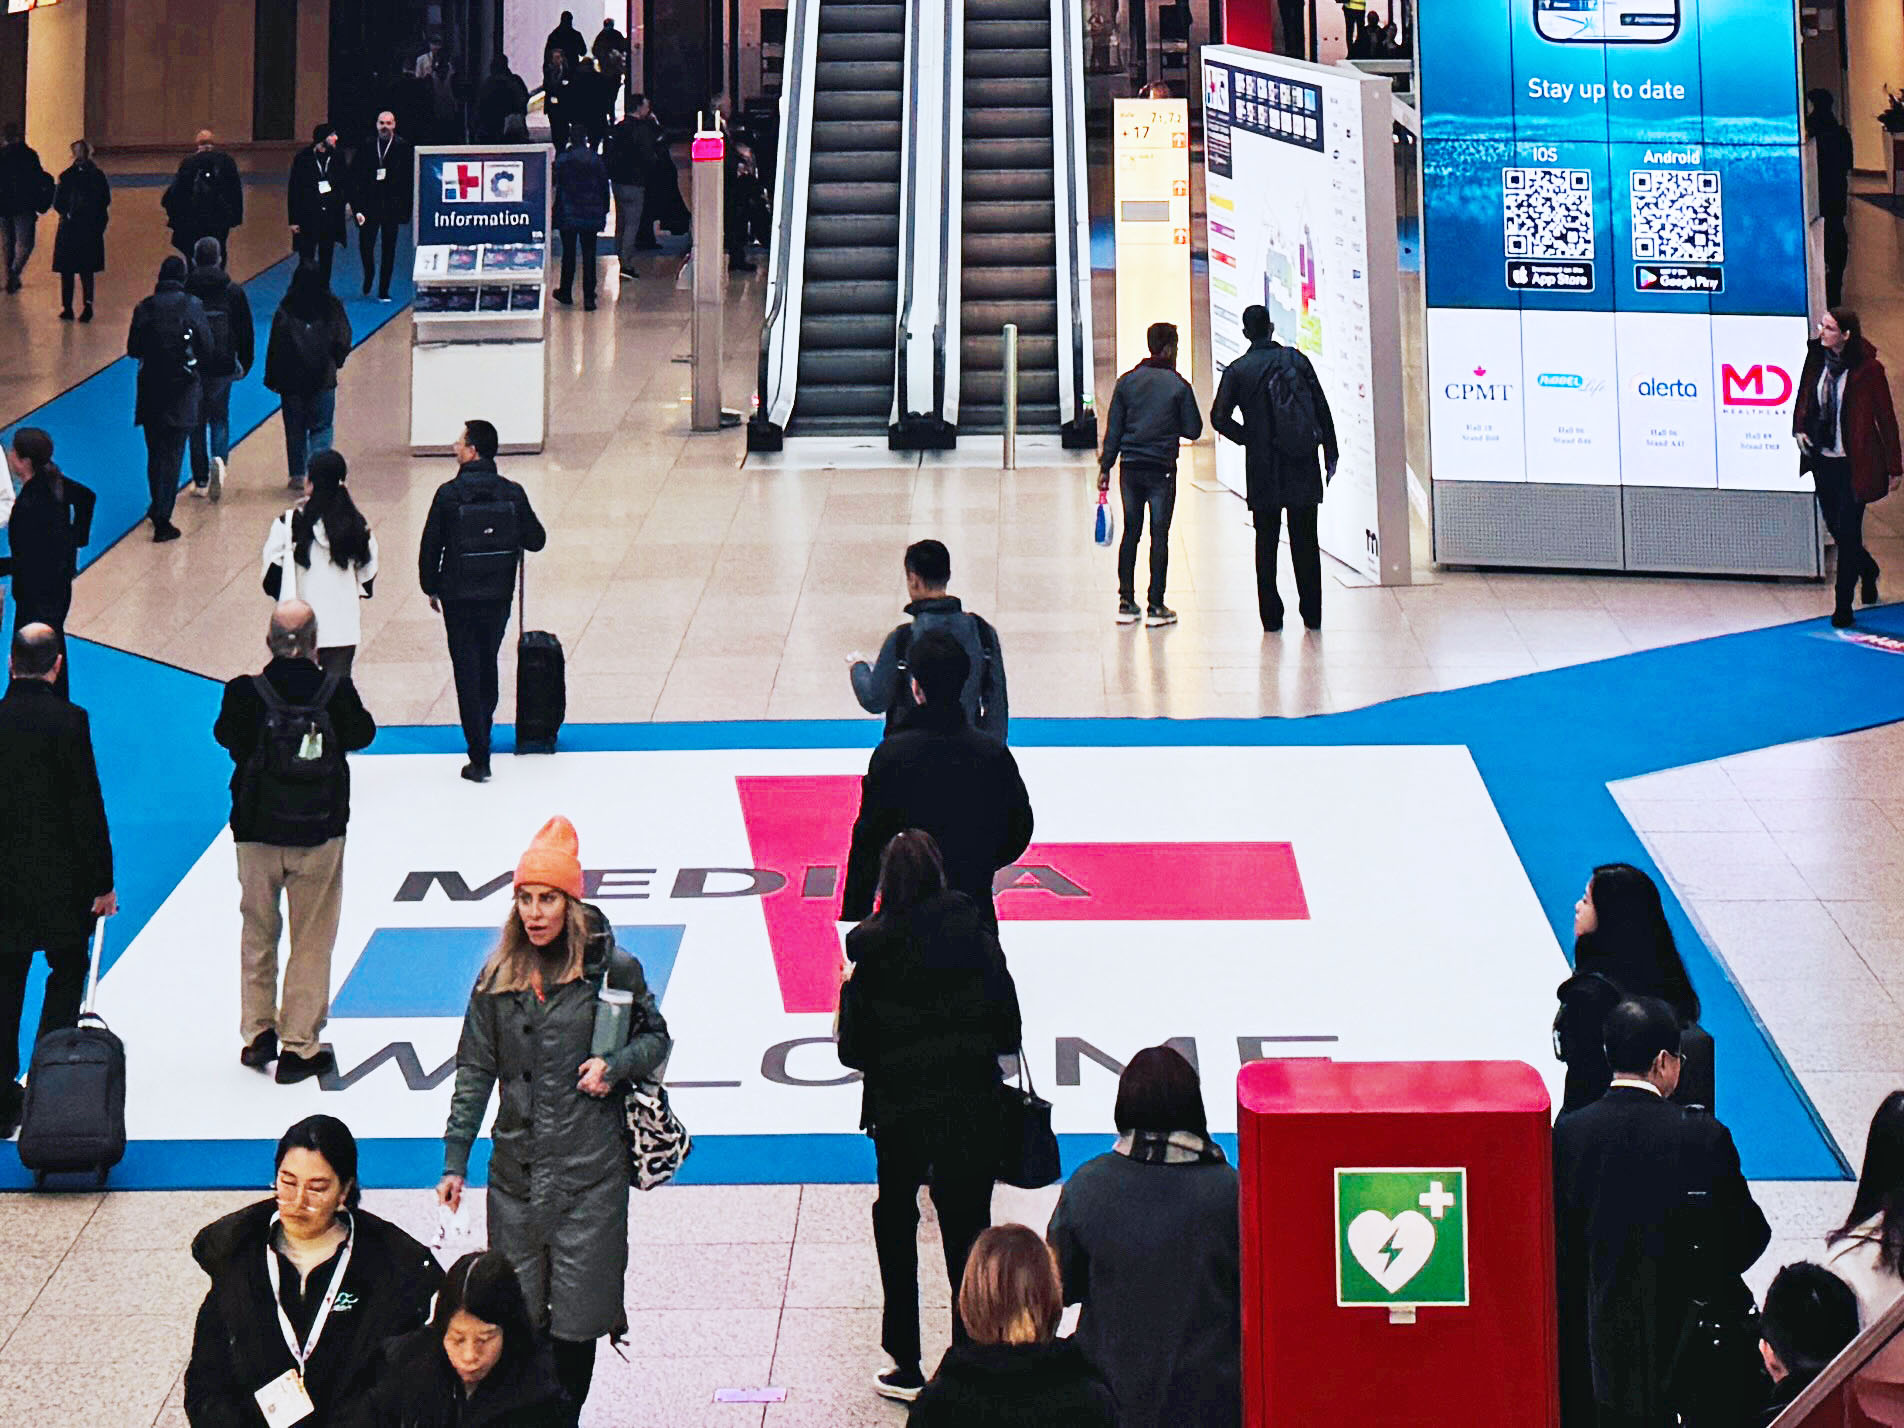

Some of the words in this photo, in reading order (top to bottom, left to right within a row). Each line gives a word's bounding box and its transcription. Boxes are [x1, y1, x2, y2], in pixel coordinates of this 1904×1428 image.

[1528, 77, 1574, 103] Stay
[1579, 83, 1606, 103] up
[1612, 79, 1633, 99] to
[1639, 79, 1685, 100] date
[1643, 149, 1701, 165] Android
[434, 209, 530, 227] Information
[1444, 382, 1514, 402] CPMT
[1638, 377, 1697, 398] alerta
[393, 864, 1094, 902] MEDIA
